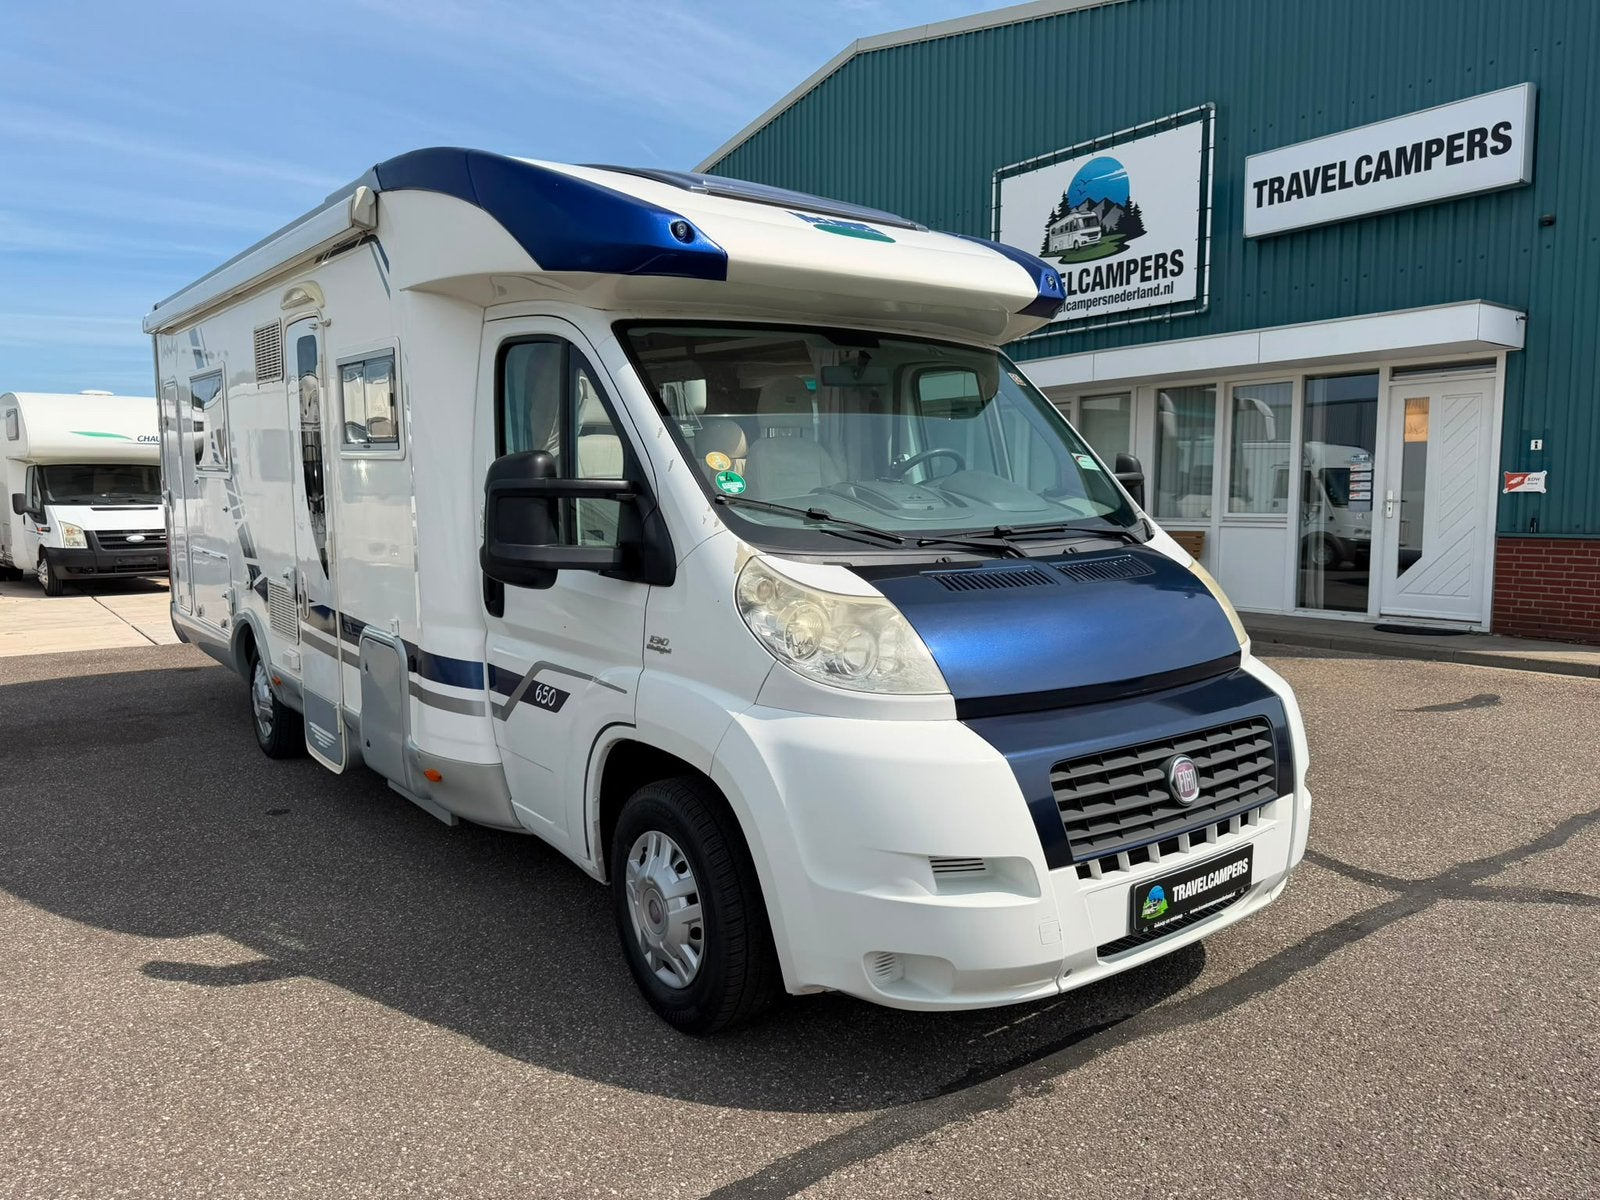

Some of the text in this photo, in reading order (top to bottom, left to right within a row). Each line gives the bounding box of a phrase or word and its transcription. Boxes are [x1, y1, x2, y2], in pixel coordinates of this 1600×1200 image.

[1253, 121, 1512, 208] TRAVELCAMPERS
[535, 683, 557, 707] 650
[1172, 858, 1248, 902] TRAVELCAMPERS
